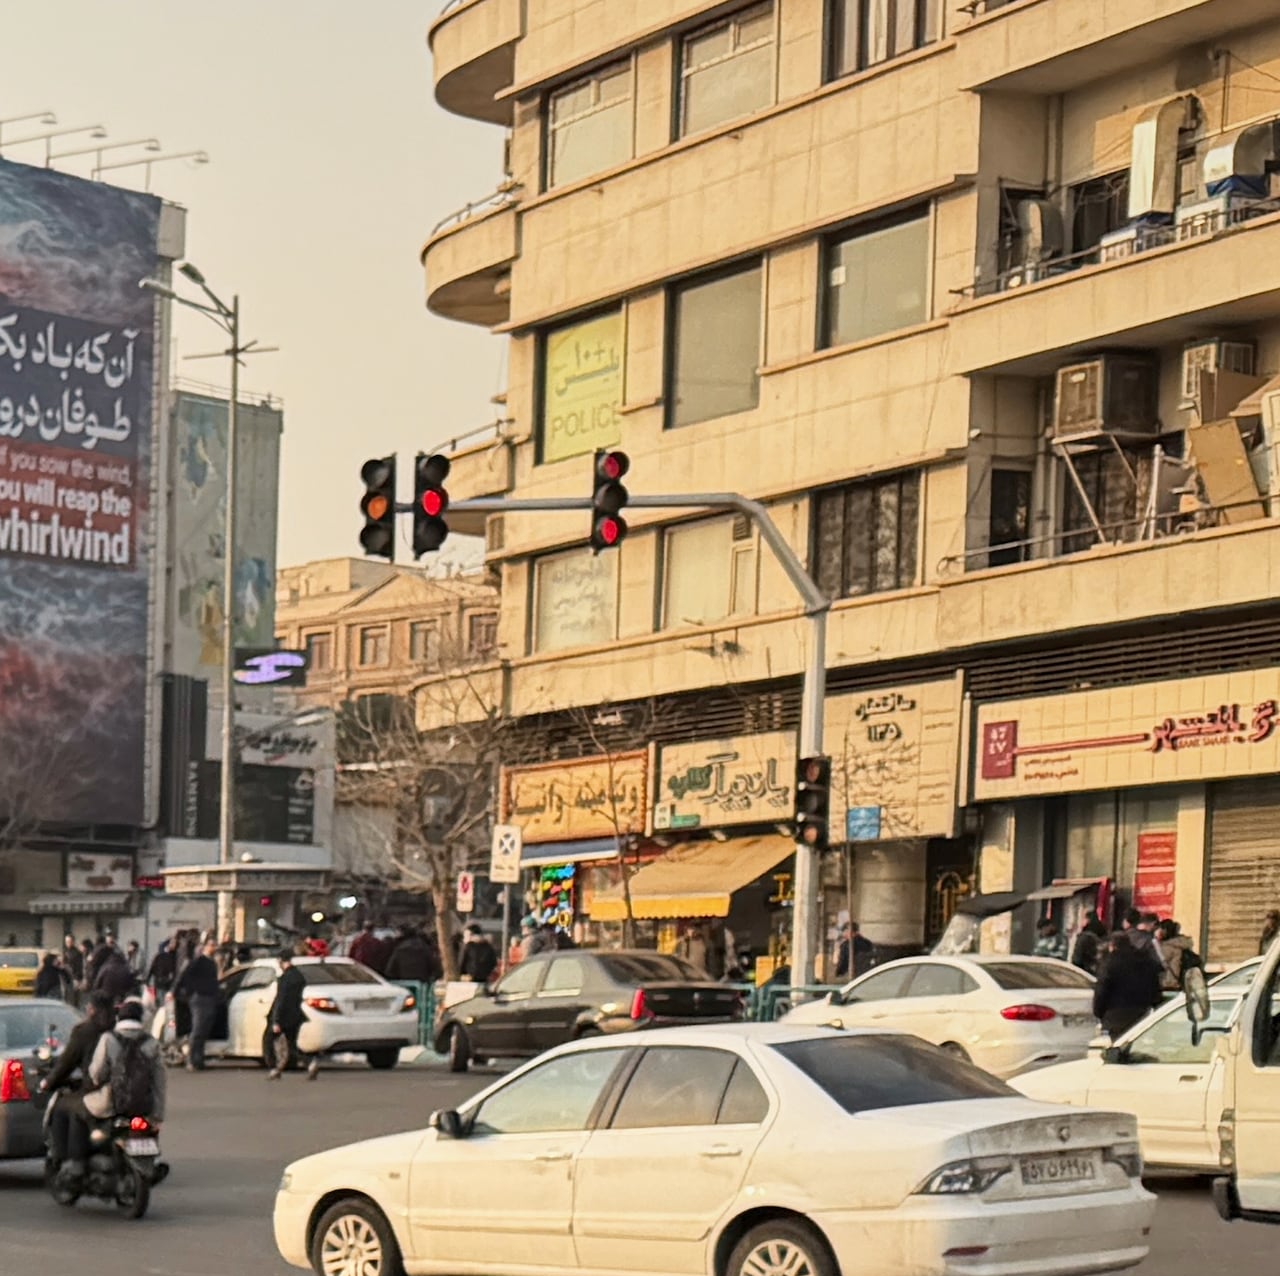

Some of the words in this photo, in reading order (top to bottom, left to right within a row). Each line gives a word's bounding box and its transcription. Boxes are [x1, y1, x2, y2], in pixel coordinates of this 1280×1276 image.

[32, 322, 72, 380] باد
[552, 401, 620, 439] POLICE
[11, 451, 36, 473] you
[72, 459, 94, 480] the
[24, 478, 55, 507] will
[57, 488, 99, 519] reap
[101, 488, 131, 517] the
